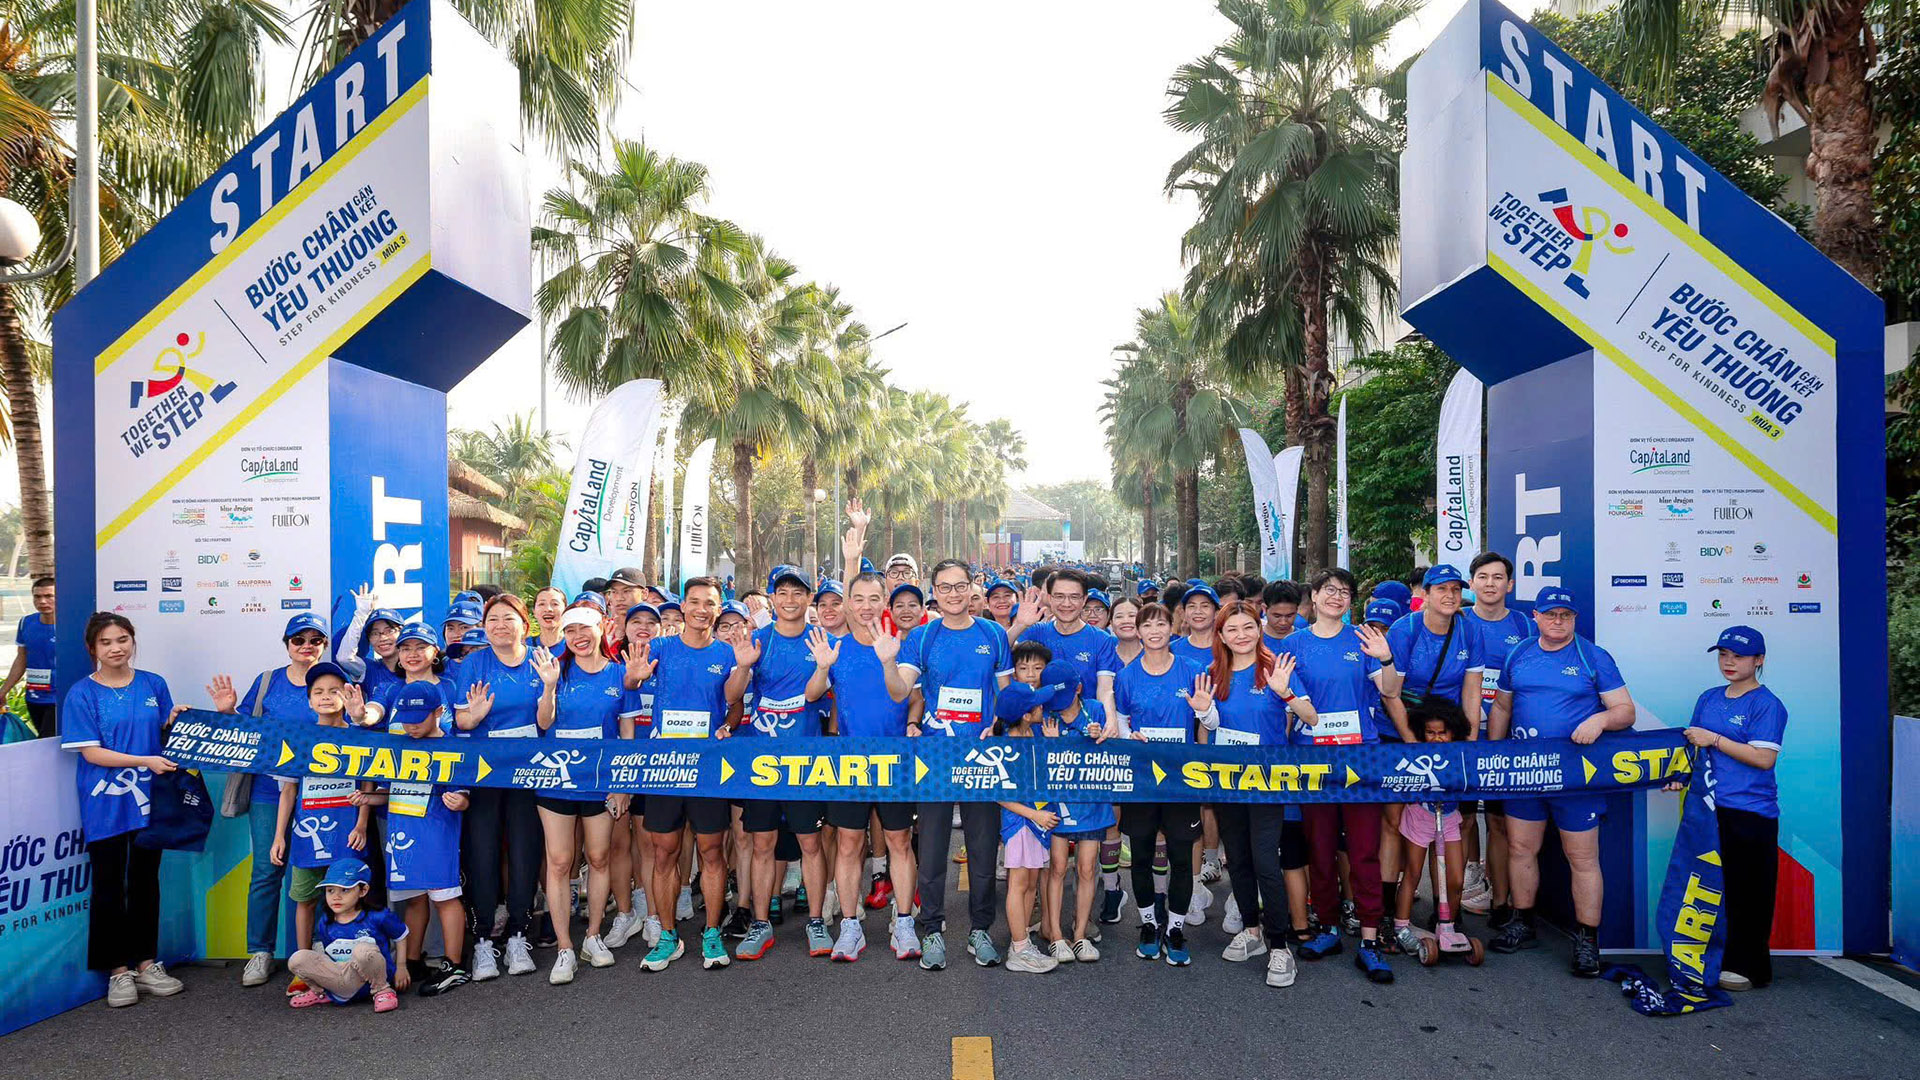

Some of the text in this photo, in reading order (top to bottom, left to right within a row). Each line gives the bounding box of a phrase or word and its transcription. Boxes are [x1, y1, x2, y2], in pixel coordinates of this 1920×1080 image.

[210, 20, 406, 254] START
[1500, 20, 1706, 235] START
[1499, 191, 1574, 251] TOGETHER
[399, 235, 407, 244] 3
[1488, 204, 1572, 272] WE STEP
[245, 202, 359, 309] BƯỚC CHÂN
[262, 209, 398, 332] YÊU THƯƠNG
[279, 261, 377, 346] STEP FOR KINDNESS
[1669, 282, 1802, 383] BƯỚC CHÂN
[1638, 331, 1747, 414] STEP FOR KINDNESS
[1651, 306, 1802, 425] YÊU THƯƠNG
[120, 385, 188, 446] TOGETHER
[130, 391, 205, 458] WE STEP
[1771, 429, 1780, 438] 3
[241, 456, 298, 474] CapitaLand
[1630, 447, 1690, 466] CapitaLand
[569, 458, 608, 553] CapitaLand
[603, 466, 624, 522] Development
[1442, 455, 1467, 552] CapitaLand
[626, 481, 639, 551] FOUNDATION
[197, 555, 220, 564] BIDV
[1700, 547, 1724, 557] BIDV
[948, 697, 973, 705] 2810
[171, 721, 248, 744] BƯỚC CHÂN
[1324, 721, 1349, 729] 1909
[165, 735, 258, 760] YÊU THƯƠNG
[611, 750, 687, 766] BƯỚC CHÂN
[1046, 750, 1118, 766] BƯỚC CHÂN
[308, 741, 465, 783] START
[514, 768, 558, 776] TOGETHER
[750, 754, 901, 787] START
[951, 766, 994, 775] TOGETHER
[1476, 752, 1548, 770] BƯỚC CHÂN
[512, 776, 562, 789] WE STEP
[611, 766, 699, 782] YÊU THƯƠNG
[951, 774, 1000, 789] WE STEP
[1048, 765, 1133, 782] YÊU THƯƠNG
[1181, 761, 1332, 791] START
[1382, 775, 1426, 784] TOGETHER
[1478, 768, 1563, 787] YÊU THƯƠNG
[1393, 783, 1430, 792] STEP
[13, 900, 89, 932] FOR KINDNE
